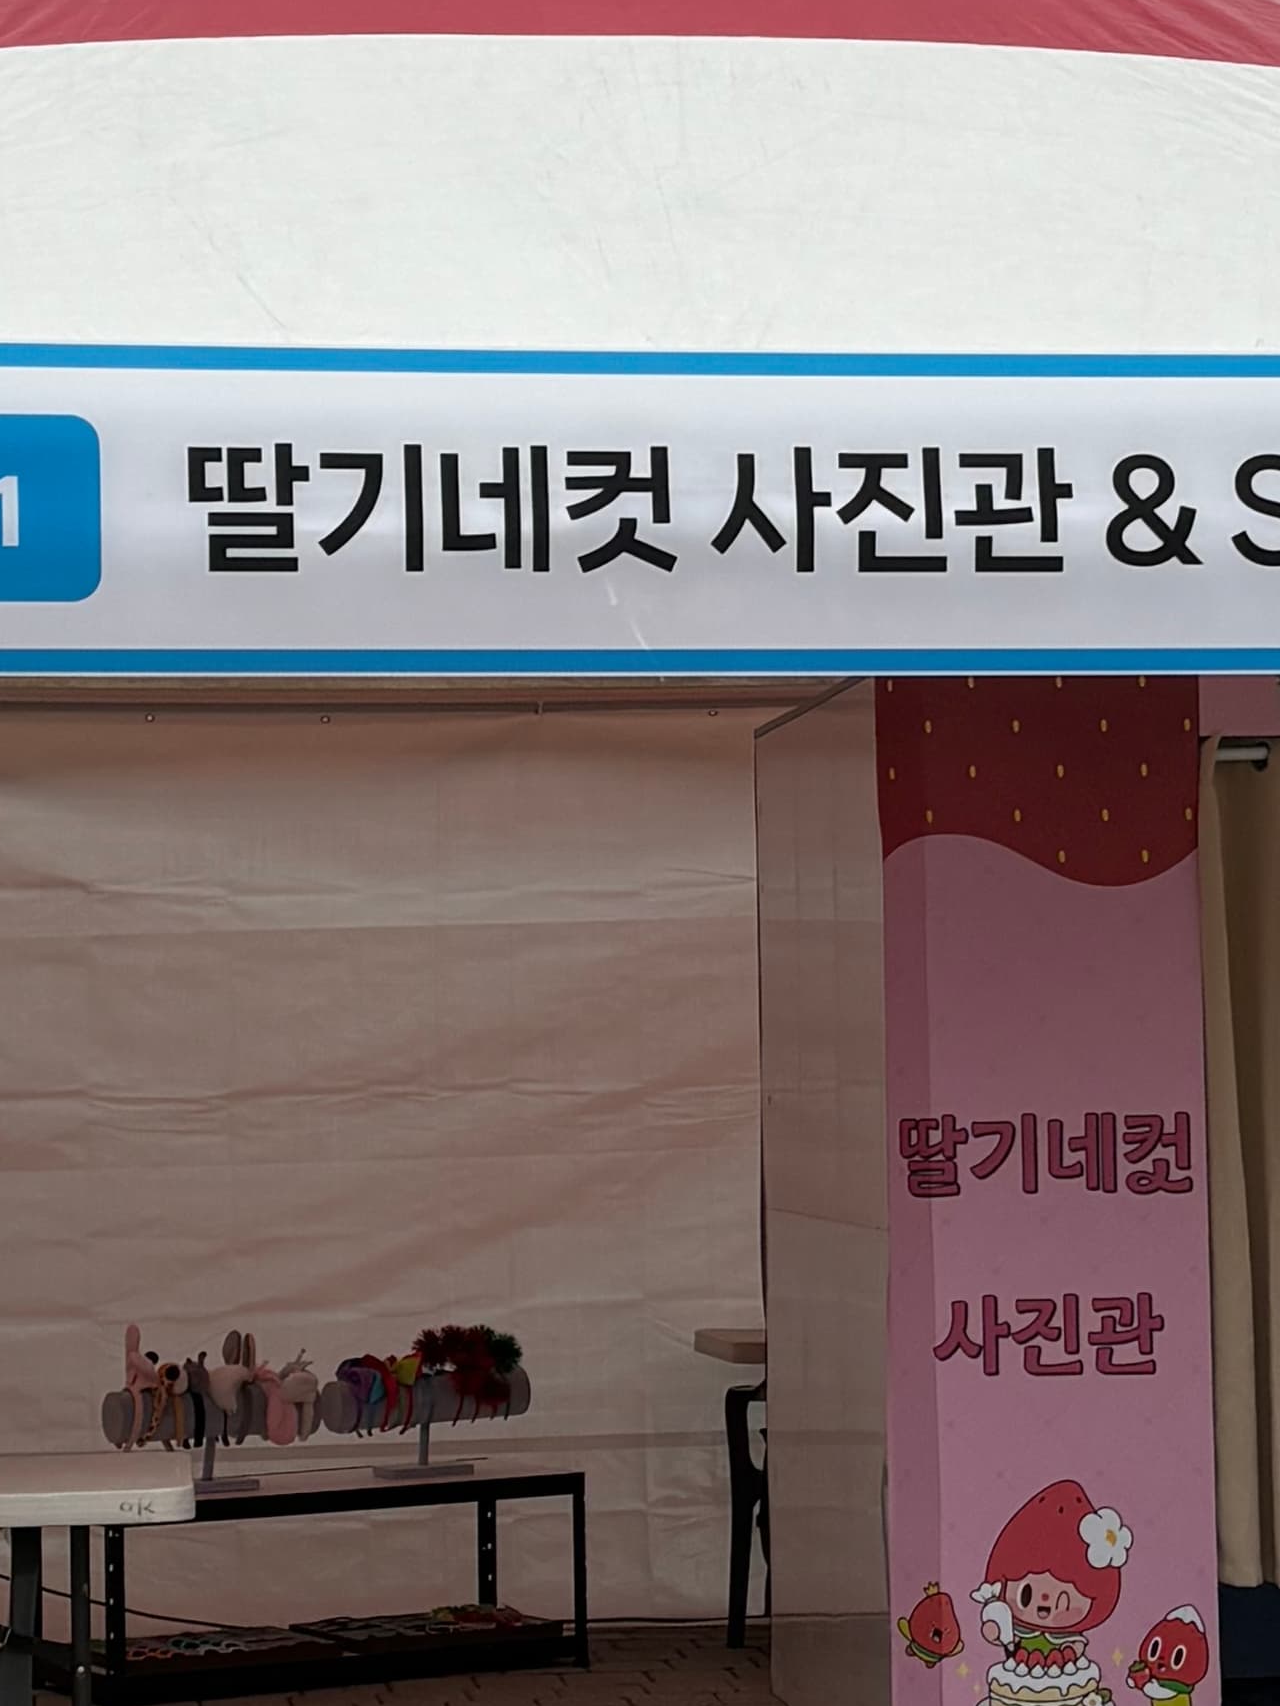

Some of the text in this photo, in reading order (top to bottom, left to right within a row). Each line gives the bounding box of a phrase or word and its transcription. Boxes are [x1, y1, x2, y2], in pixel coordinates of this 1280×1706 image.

[187, 443, 678, 575] 딸기네컷
[710, 445, 1074, 574] 사진관
[1104, 453, 1203, 567] &
[898, 1111, 1195, 1199] 딸기네컷
[932, 1292, 1165, 1377] 사진관
